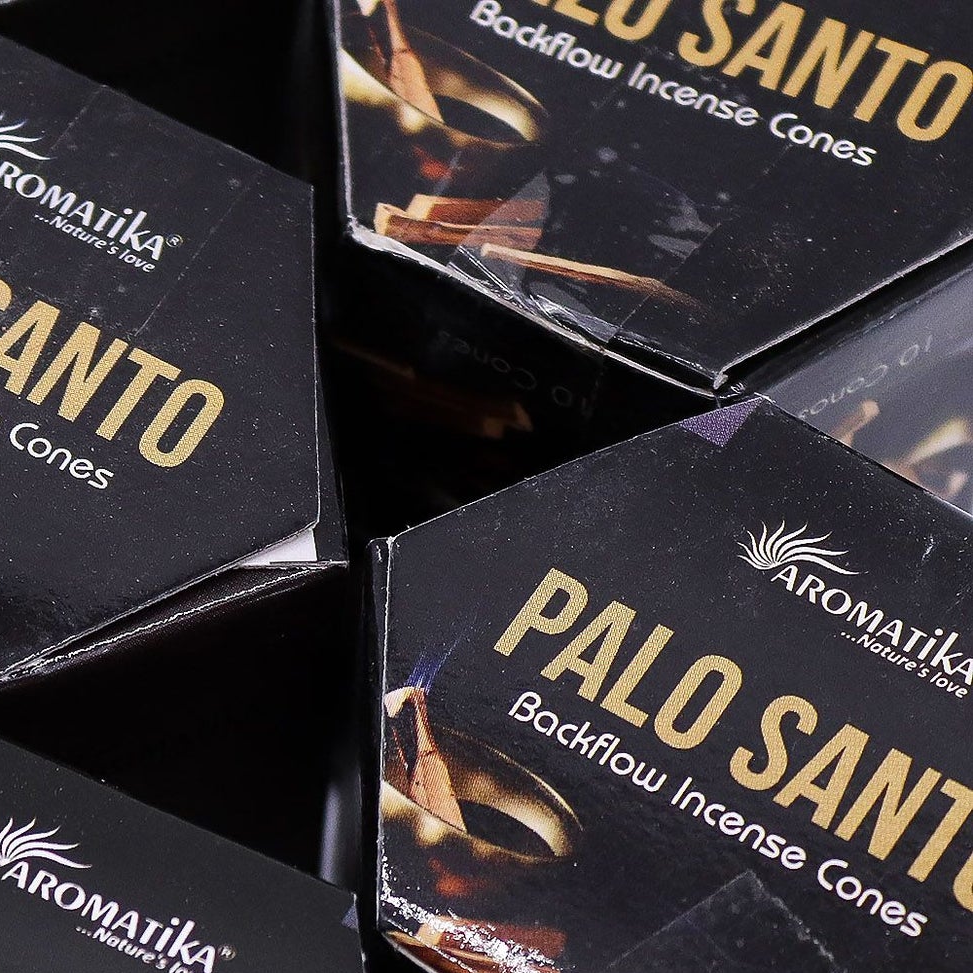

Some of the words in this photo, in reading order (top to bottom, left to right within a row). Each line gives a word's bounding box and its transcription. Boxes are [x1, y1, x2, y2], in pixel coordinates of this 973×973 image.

[469, 0, 623, 80] Backflow
[628, 61, 758, 128] Incense
[769, 112, 877, 167] Cones
[678, 0, 973, 142] SANTO
[119, 249, 155, 273] love
[10, 422, 114, 490] Cones
[493, 567, 743, 749] PALO
[729, 694, 973, 912] SANT
[929, 672, 968, 699] love
[508, 691, 668, 793] Backflow
[670, 777, 806, 871] Incense
[816, 859, 929, 938] Cones
